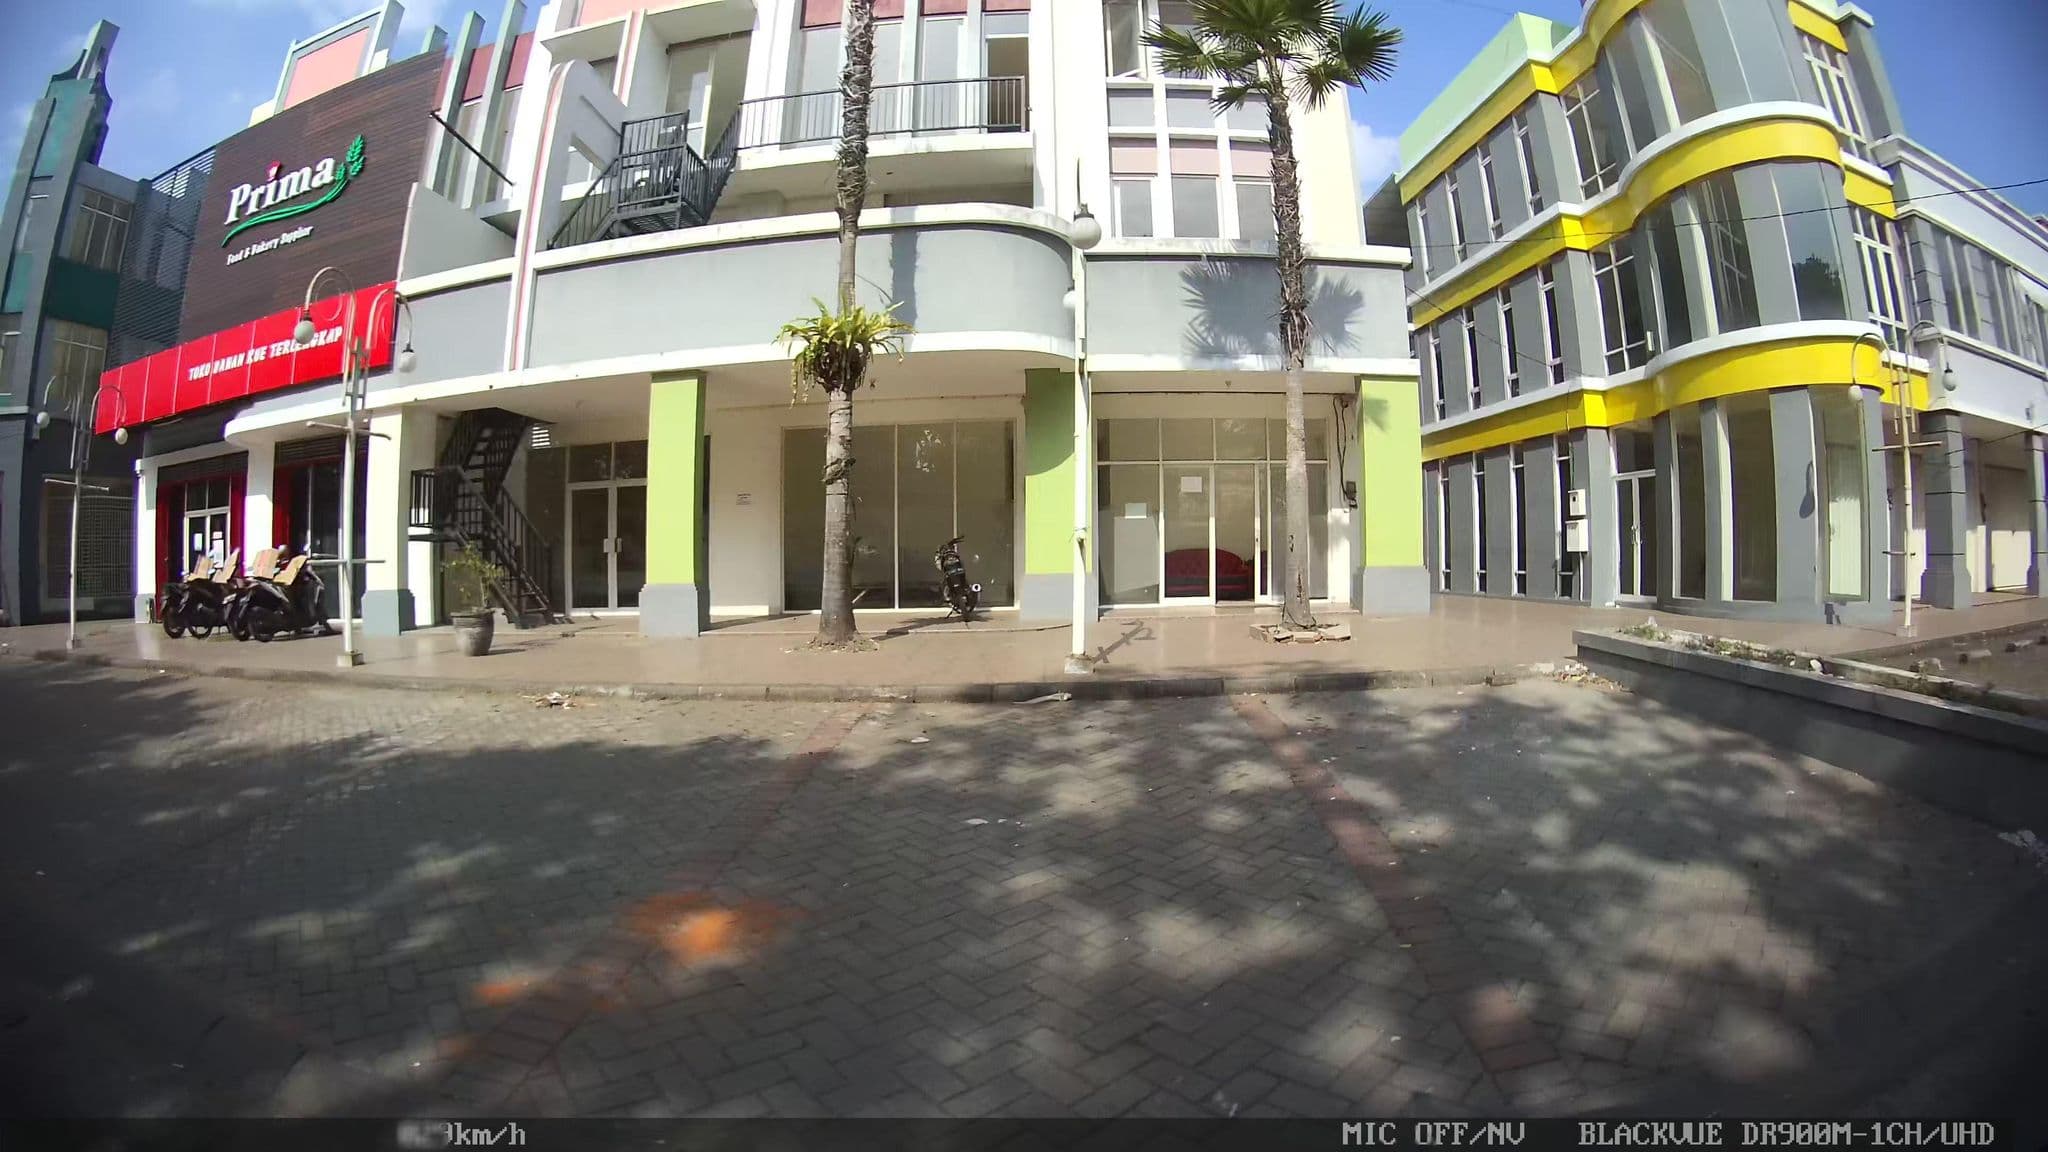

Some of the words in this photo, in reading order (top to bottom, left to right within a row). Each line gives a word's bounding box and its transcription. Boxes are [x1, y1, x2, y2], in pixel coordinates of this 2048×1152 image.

[224, 157, 336, 225] Prima
[226, 250, 244, 266] Food
[251, 238, 280, 256] Bakery
[280, 226, 314, 245] Supplier
[188, 362, 211, 382] TOKO
[213, 352, 246, 375] BAHAN
[245, 345, 268, 365] KUE
[269, 326, 343, 359] TERLGKAP
